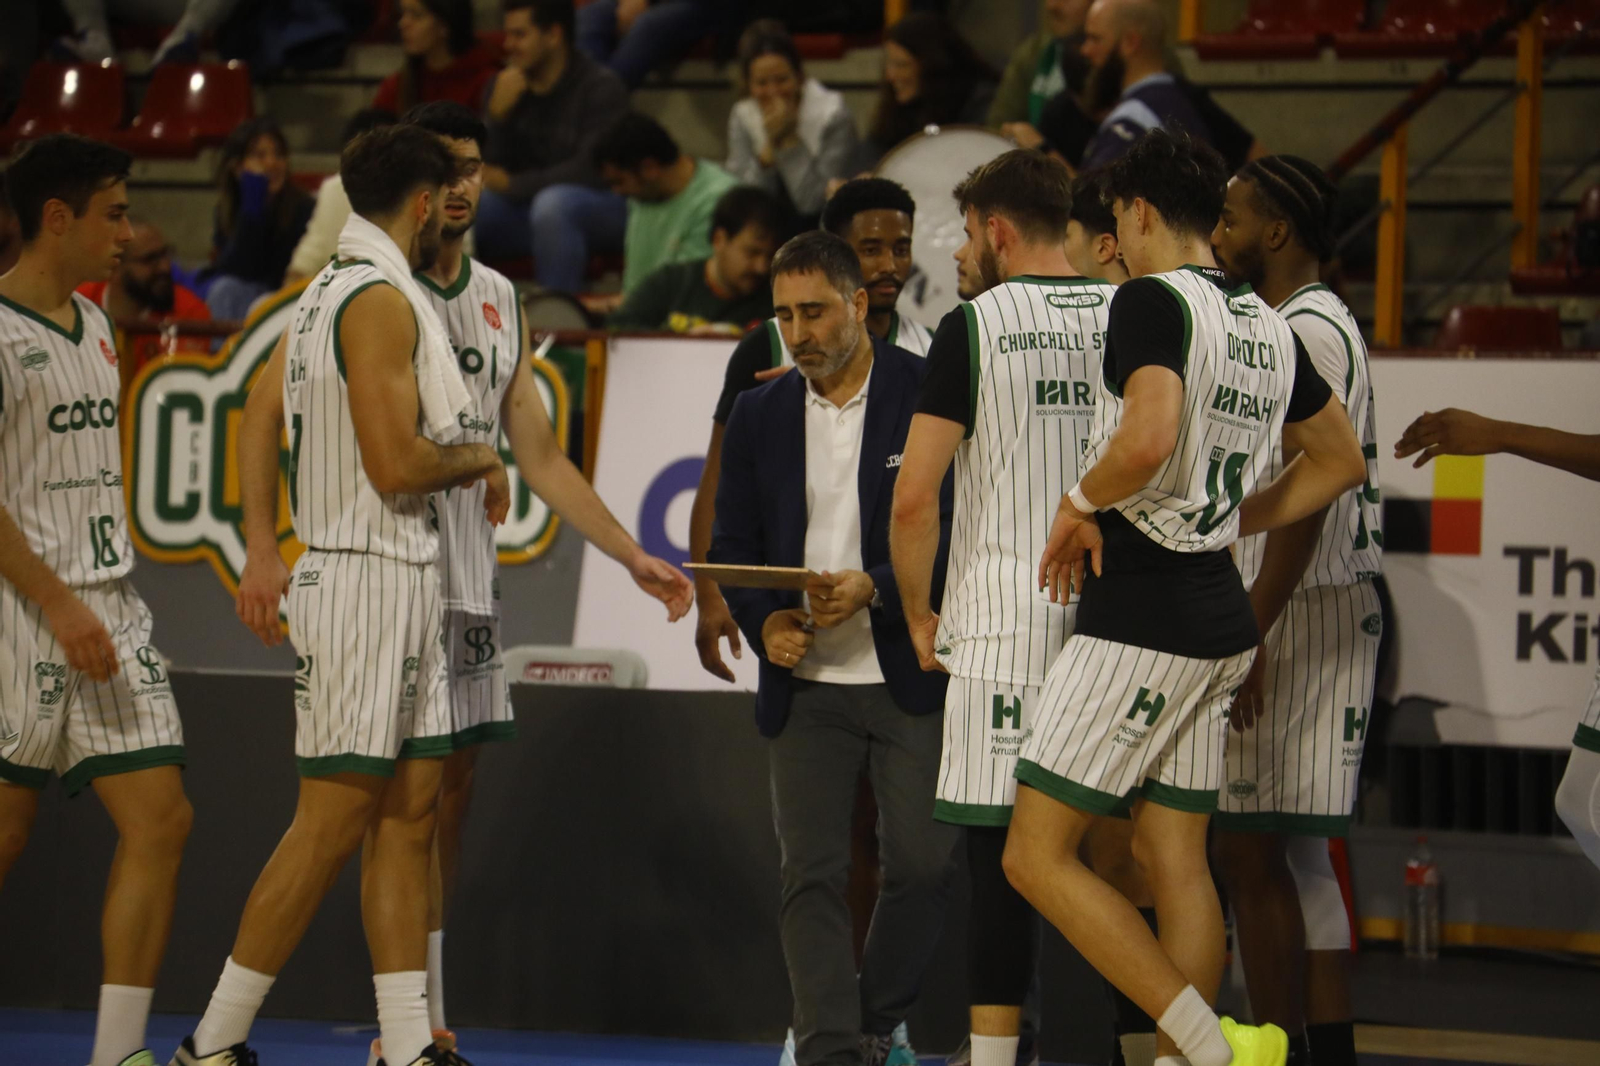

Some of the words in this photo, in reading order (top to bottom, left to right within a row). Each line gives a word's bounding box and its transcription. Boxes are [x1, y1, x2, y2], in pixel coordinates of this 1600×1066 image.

[999, 331, 1084, 354] CHURCHILL
[299, 570, 320, 582] PRO
[1503, 546, 1600, 598] Th
[990, 746, 1020, 756] Arruzaf
